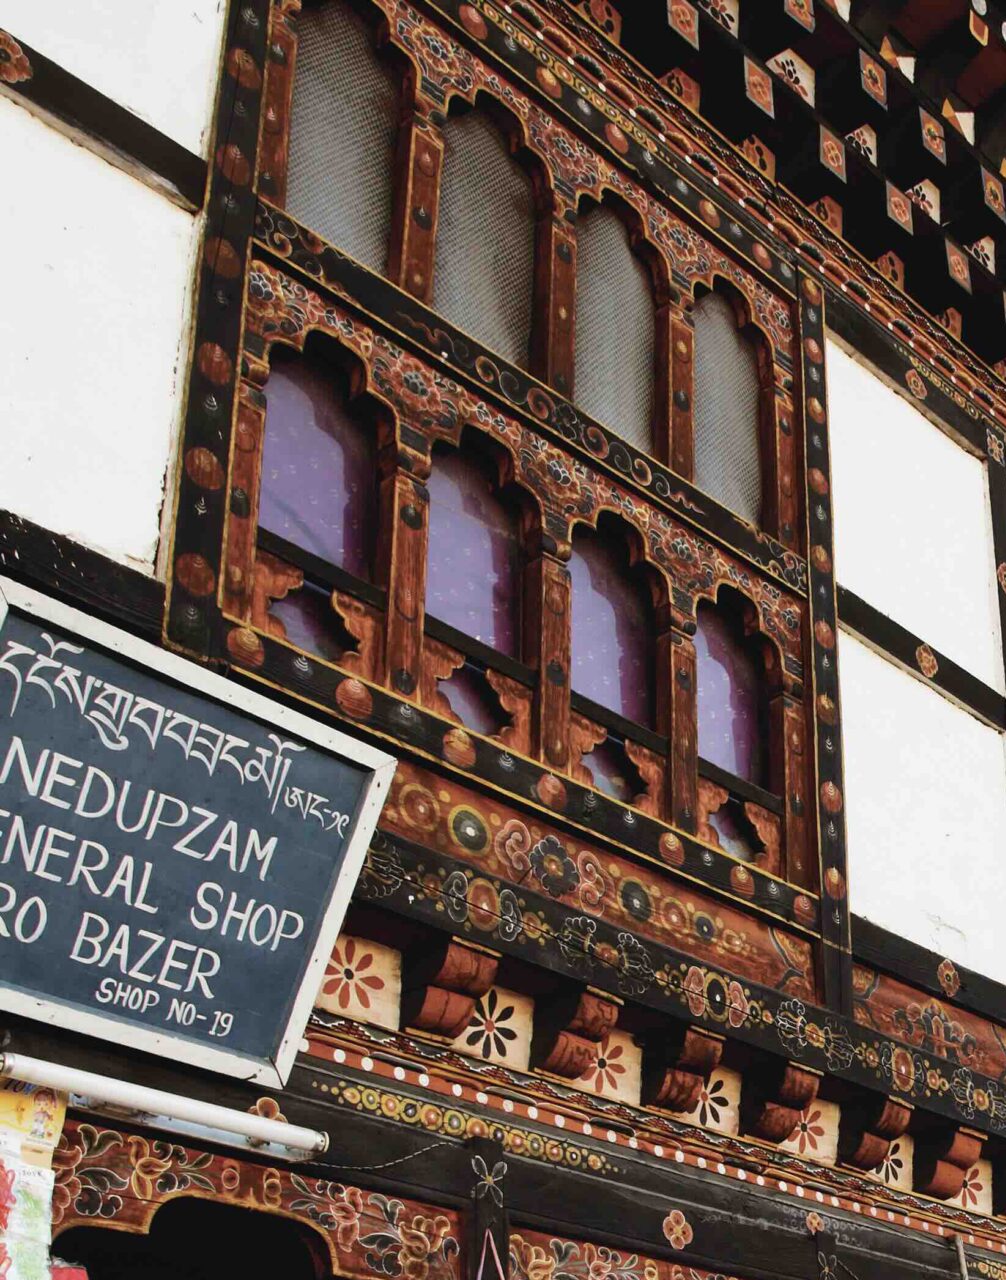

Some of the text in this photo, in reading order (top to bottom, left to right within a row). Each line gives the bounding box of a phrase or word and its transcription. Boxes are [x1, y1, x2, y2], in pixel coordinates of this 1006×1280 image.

[0, 735, 278, 881] NEDUPZAM
[69, 911, 221, 999] BAZER
[190, 882, 304, 952] SHOP
[95, 977, 160, 1013] SHOP
